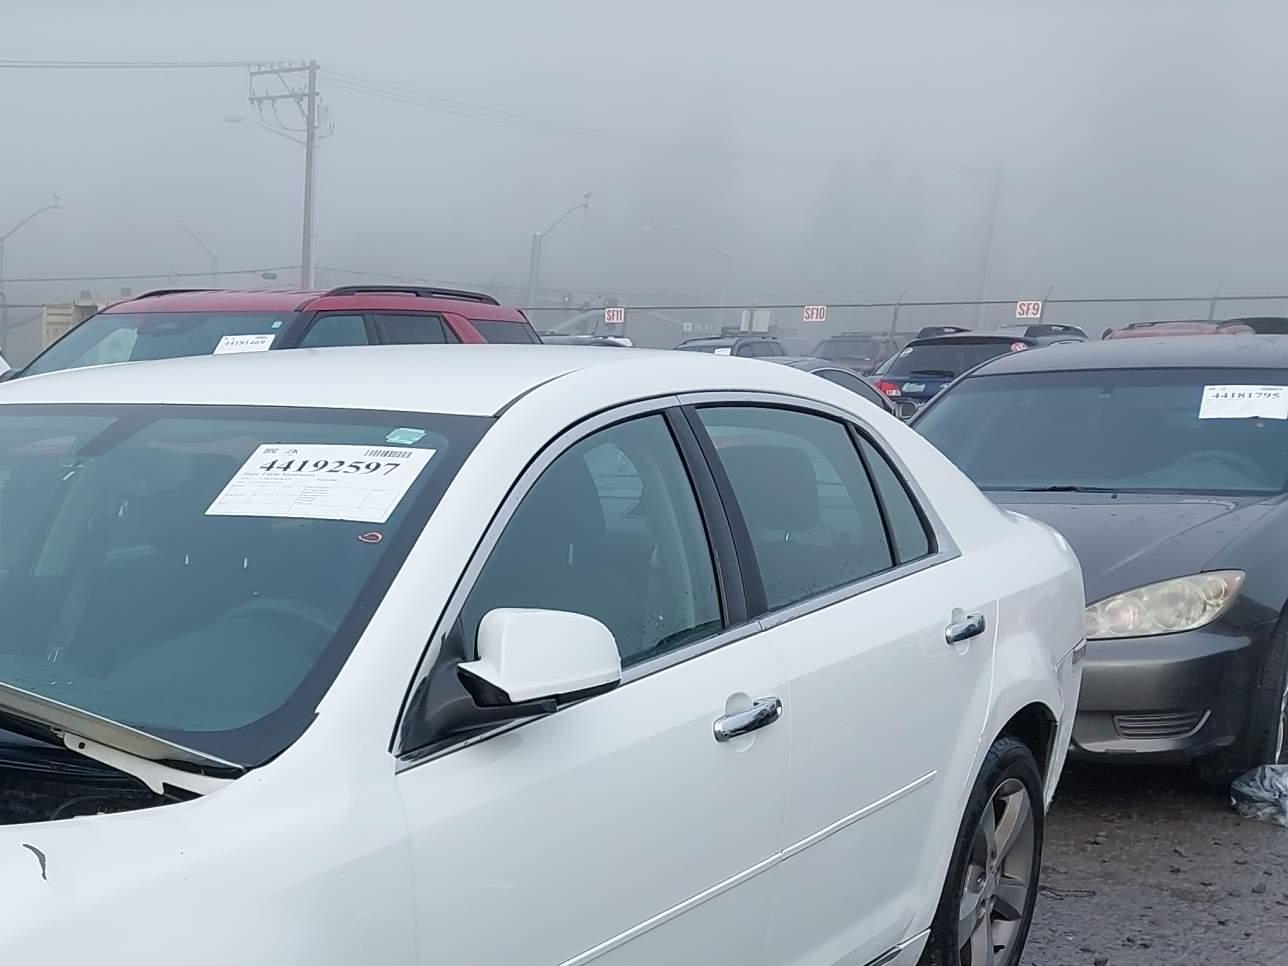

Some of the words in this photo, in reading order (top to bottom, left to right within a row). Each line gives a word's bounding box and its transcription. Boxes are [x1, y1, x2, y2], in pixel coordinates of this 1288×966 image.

[606, 309, 623, 321] SF11
[804, 307, 825, 320] SF10
[1017, 302, 1040, 316] SF9
[259, 459, 401, 477] 44192597
